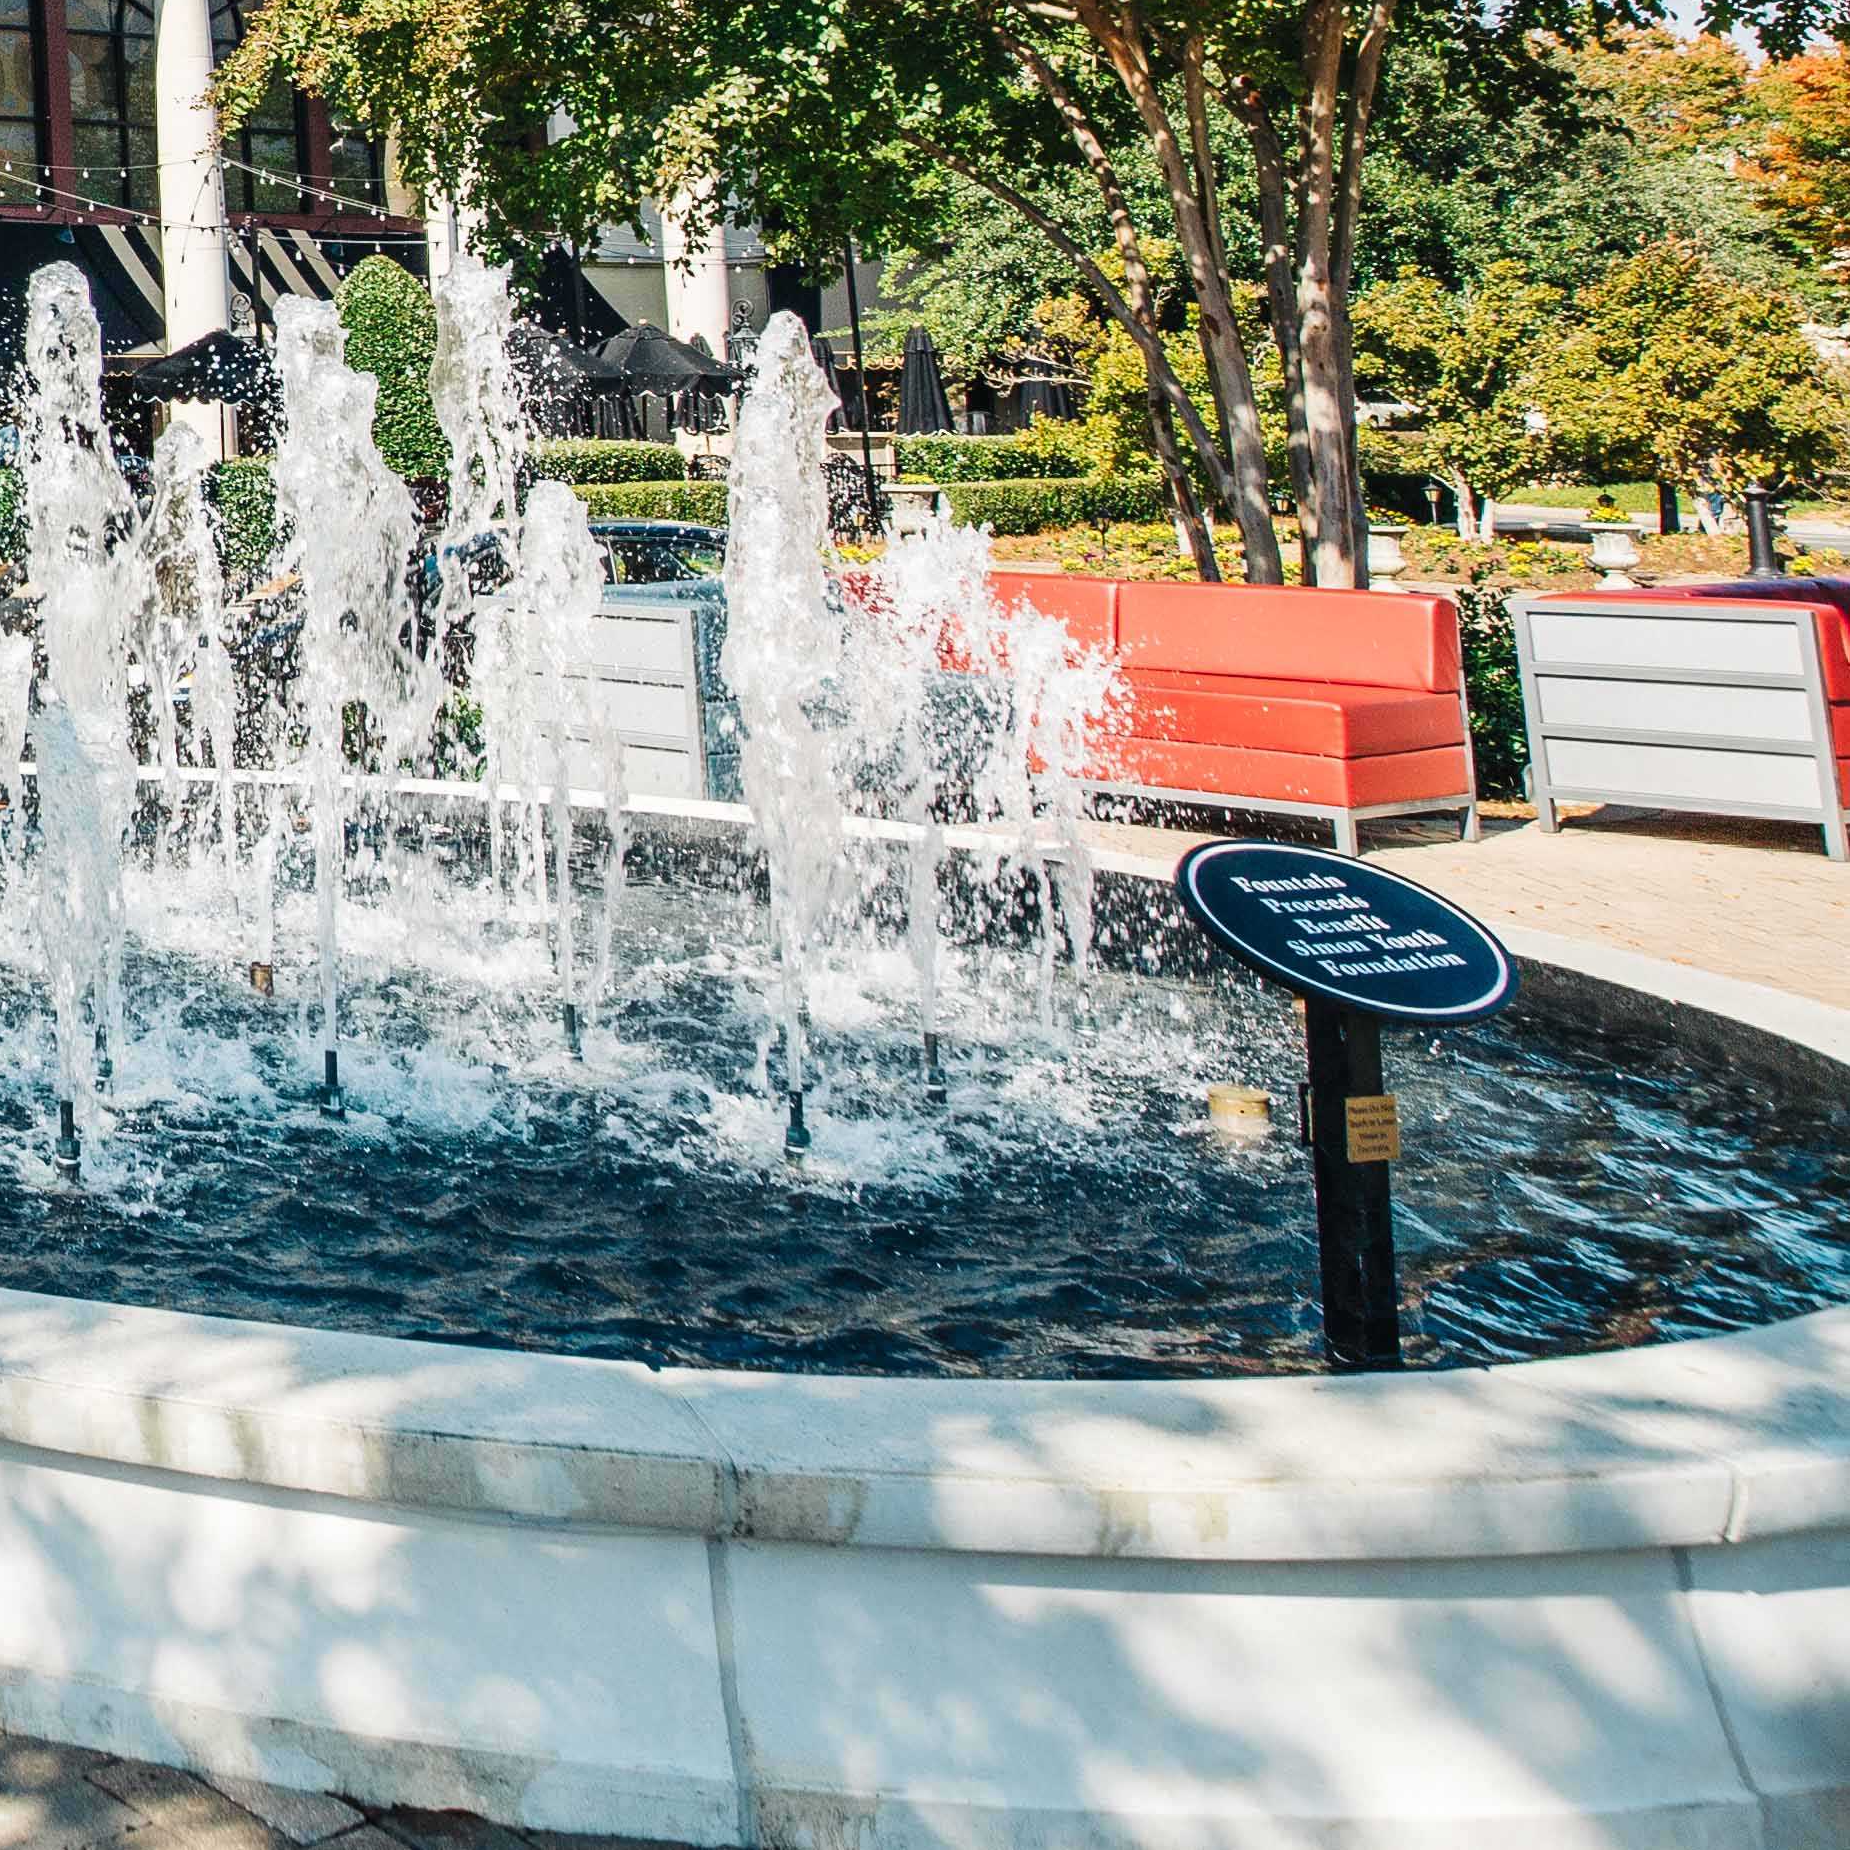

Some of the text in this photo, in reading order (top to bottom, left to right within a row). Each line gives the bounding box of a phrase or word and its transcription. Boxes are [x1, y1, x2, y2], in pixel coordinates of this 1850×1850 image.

[1230, 873, 1348, 893] Fountain
[1259, 893, 1371, 914] Proceeds
[1292, 914, 1392, 935] Benefit
[1286, 928, 1449, 957] Simon Youth
[1316, 951, 1468, 977] Foundation
